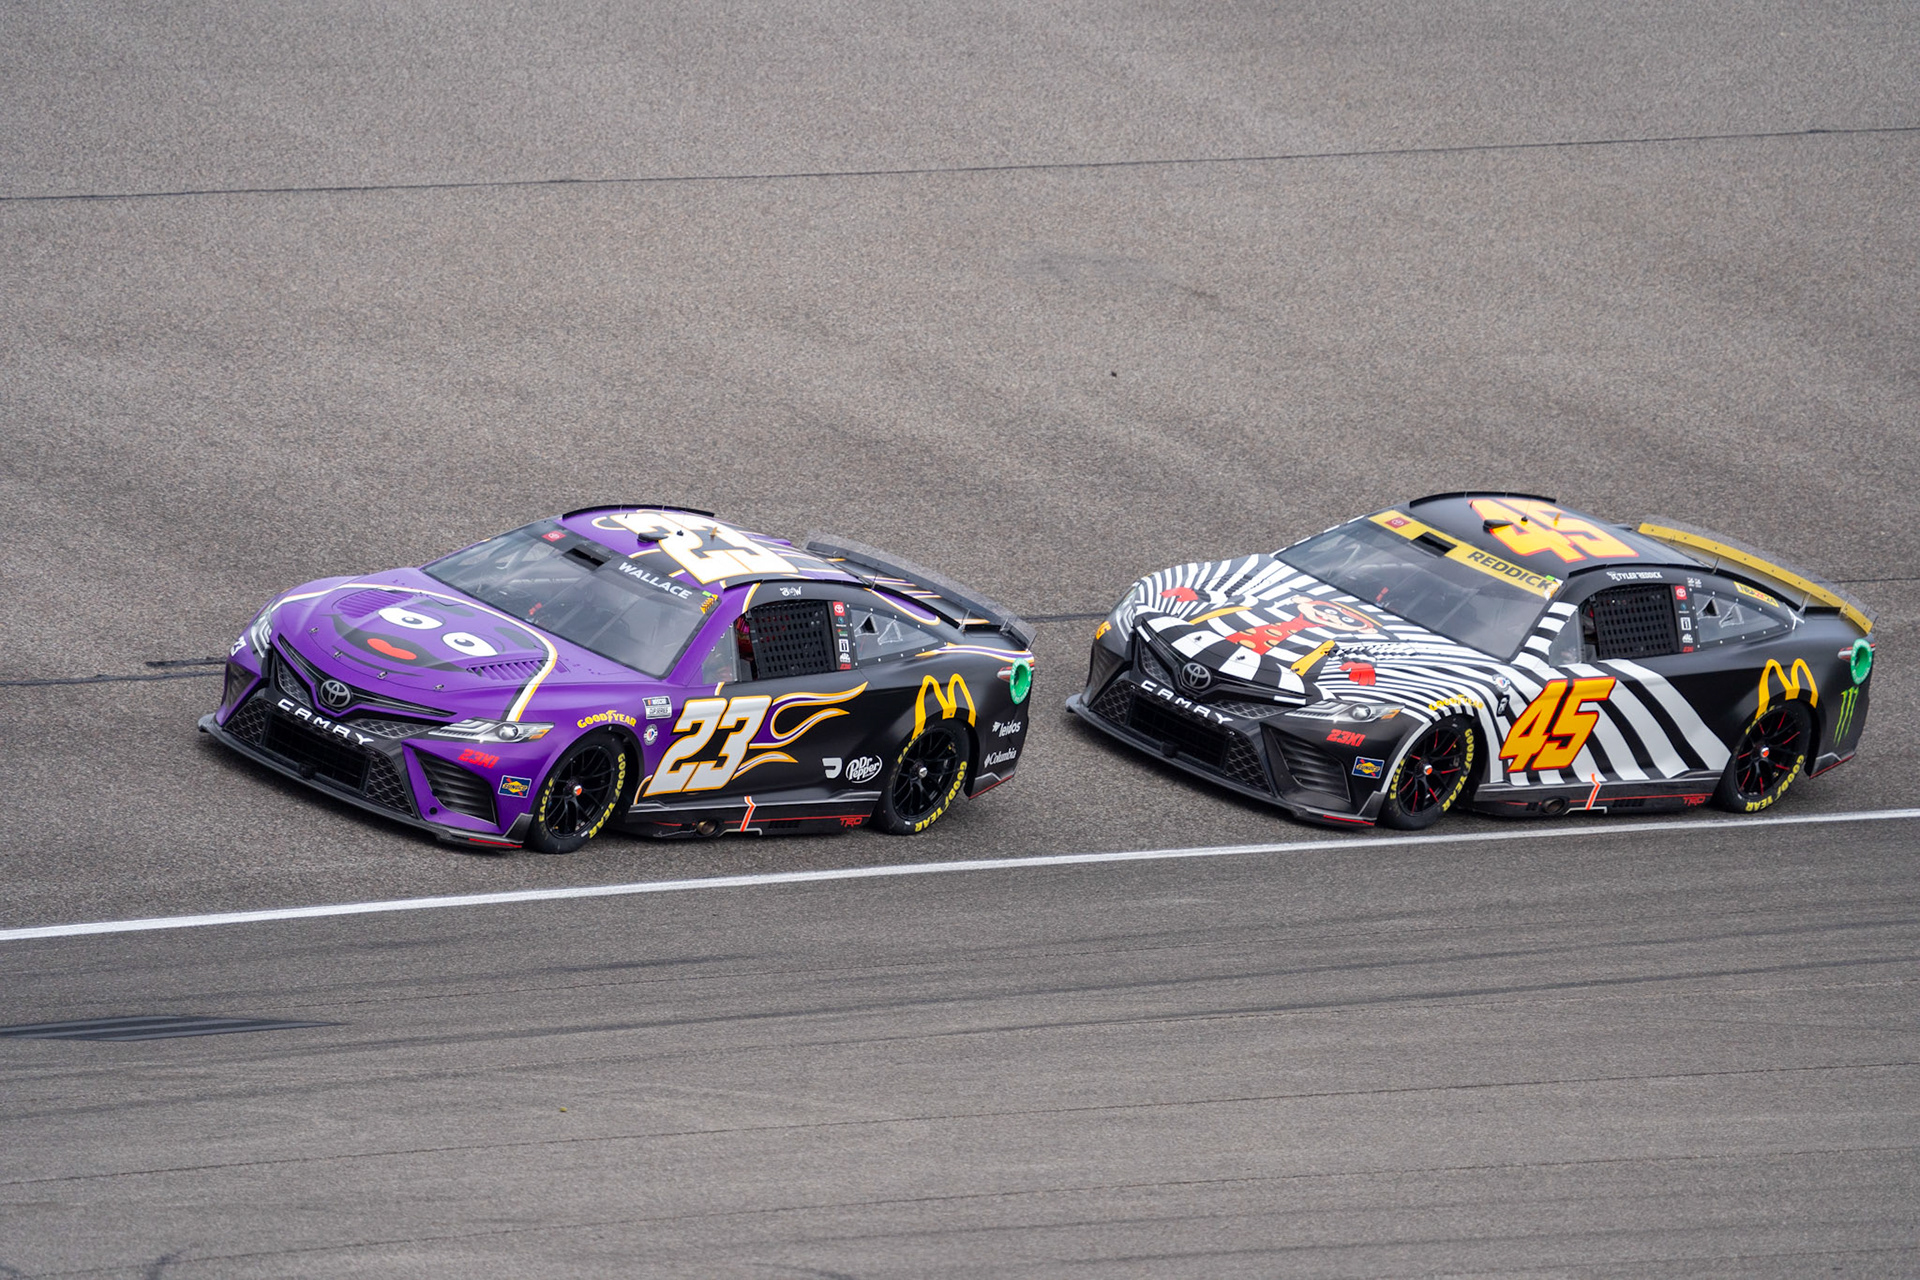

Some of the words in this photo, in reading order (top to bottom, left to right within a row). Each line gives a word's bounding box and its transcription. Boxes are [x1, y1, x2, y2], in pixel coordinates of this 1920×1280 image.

[609, 512, 799, 585] 23
[1466, 498, 1640, 564] 45
[618, 561, 693, 600] WALLACE
[1467, 550, 1554, 590] REDDICK
[277, 698, 374, 746] CAMRY
[577, 709, 637, 729] GOODYEAR
[1140, 679, 1234, 725] CAMRY
[1427, 694, 1485, 712] GOODYEAR
[998, 720, 1022, 738] leidos
[1325, 728, 1367, 748] 23XI
[1499, 676, 1616, 773] 45
[457, 748, 500, 769] 23XI
[642, 694, 773, 798] 23
[859, 756, 873, 769] Dr
[988, 747, 1017, 766] Columbia
[501, 782, 529, 793] SUNOCO
[848, 758, 880, 781] Pepper
[1355, 763, 1382, 773] SUNOCO
[1389, 757, 1406, 800] EAGLE
[1442, 728, 1475, 812] GOODYEAR
[1745, 754, 1805, 812] GOODYEAR
[538, 777, 555, 823] EAGLE
[588, 752, 626, 839] GOODYEAR
[914, 760, 968, 832] GOODYEAR
[839, 816, 863, 829] TRD
